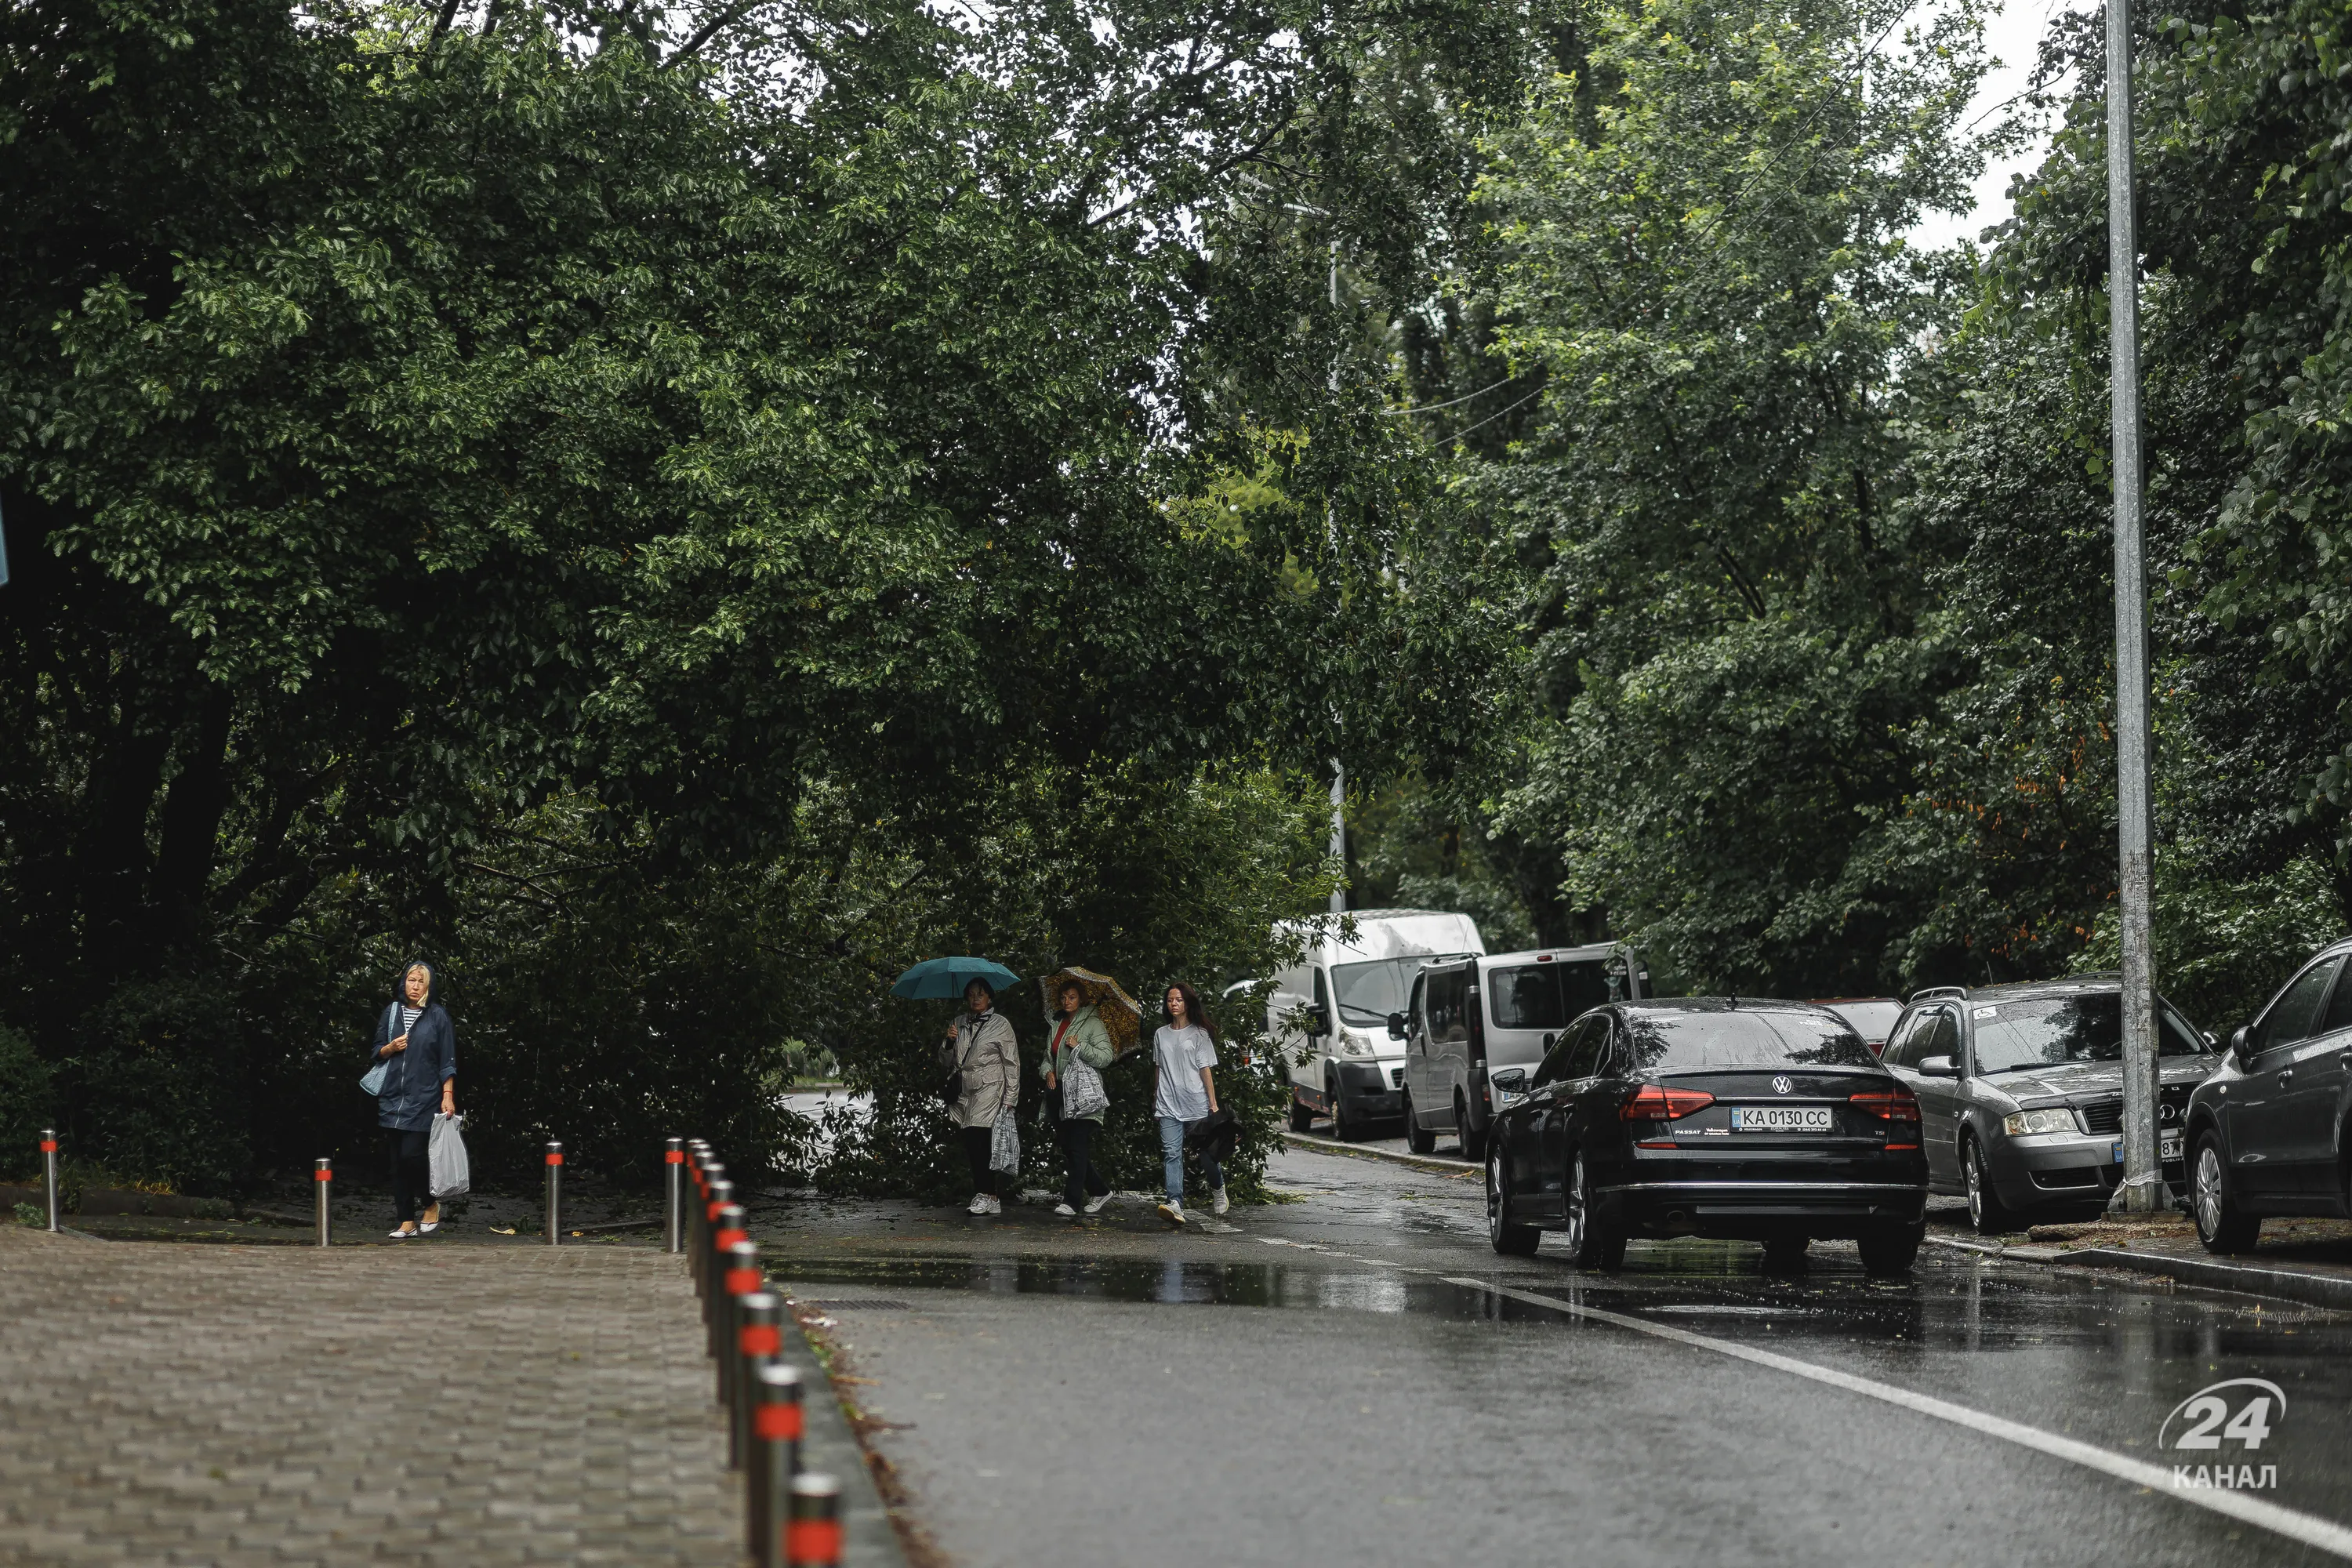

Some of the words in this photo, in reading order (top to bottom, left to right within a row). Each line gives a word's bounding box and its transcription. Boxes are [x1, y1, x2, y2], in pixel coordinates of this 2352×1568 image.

[1743, 1110, 1766, 1125] KA
[1769, 1110, 1802, 1125] 0130
[1806, 1111, 1828, 1125] CC
